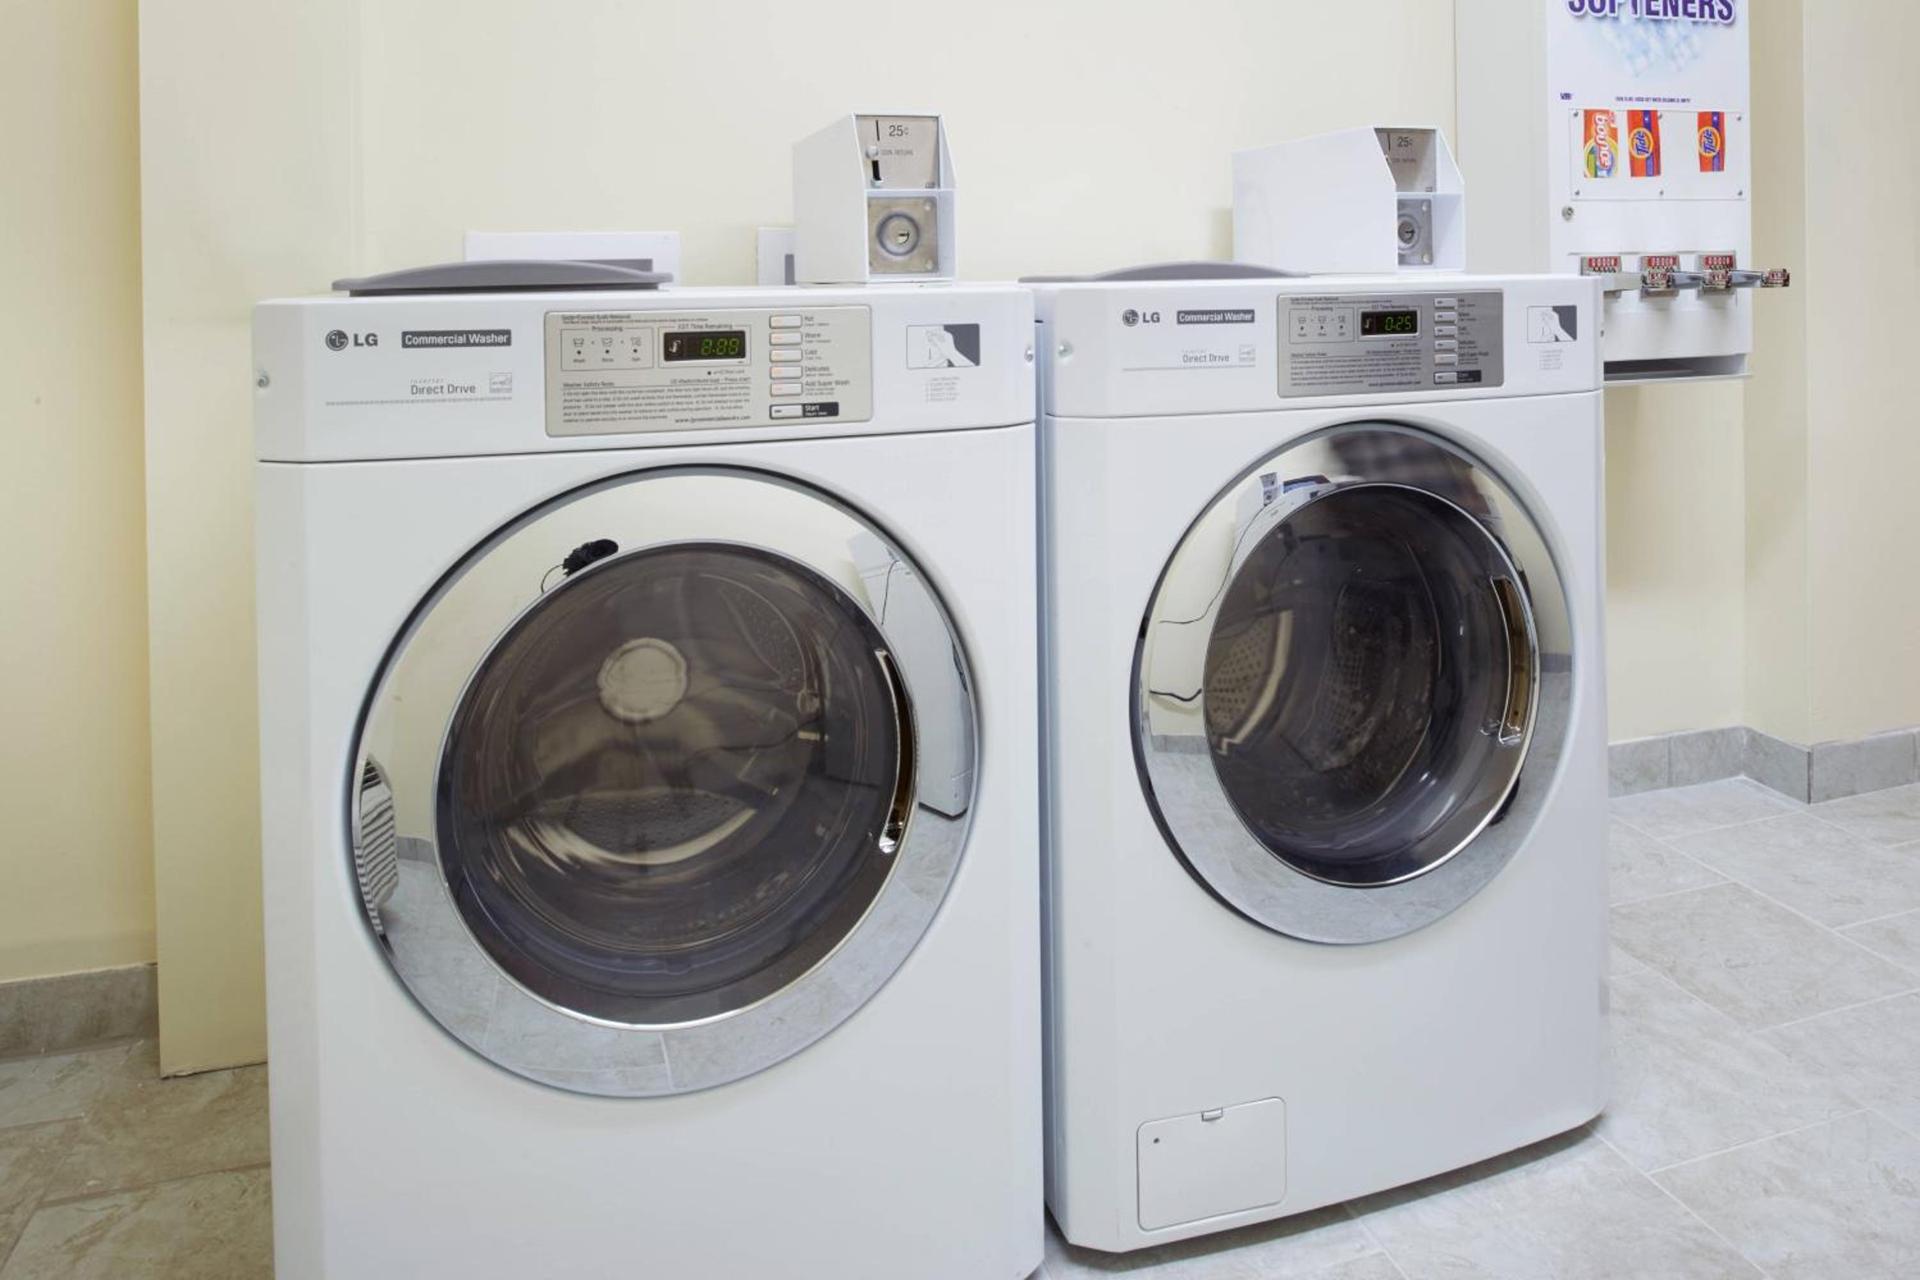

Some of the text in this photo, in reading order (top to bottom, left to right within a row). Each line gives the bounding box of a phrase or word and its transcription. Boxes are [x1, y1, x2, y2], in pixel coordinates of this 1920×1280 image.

[1635, 130, 1649, 156] Tide
[1703, 129, 1716, 154] Tide
[1142, 311, 1161, 324] LG
[1179, 310, 1253, 323] Commercial Washer
[353, 333, 378, 347] LG
[405, 333, 509, 346] Commercial Washer
[1182, 352, 1230, 364] Direct Drive
[410, 383, 476, 396] Direct Drive
